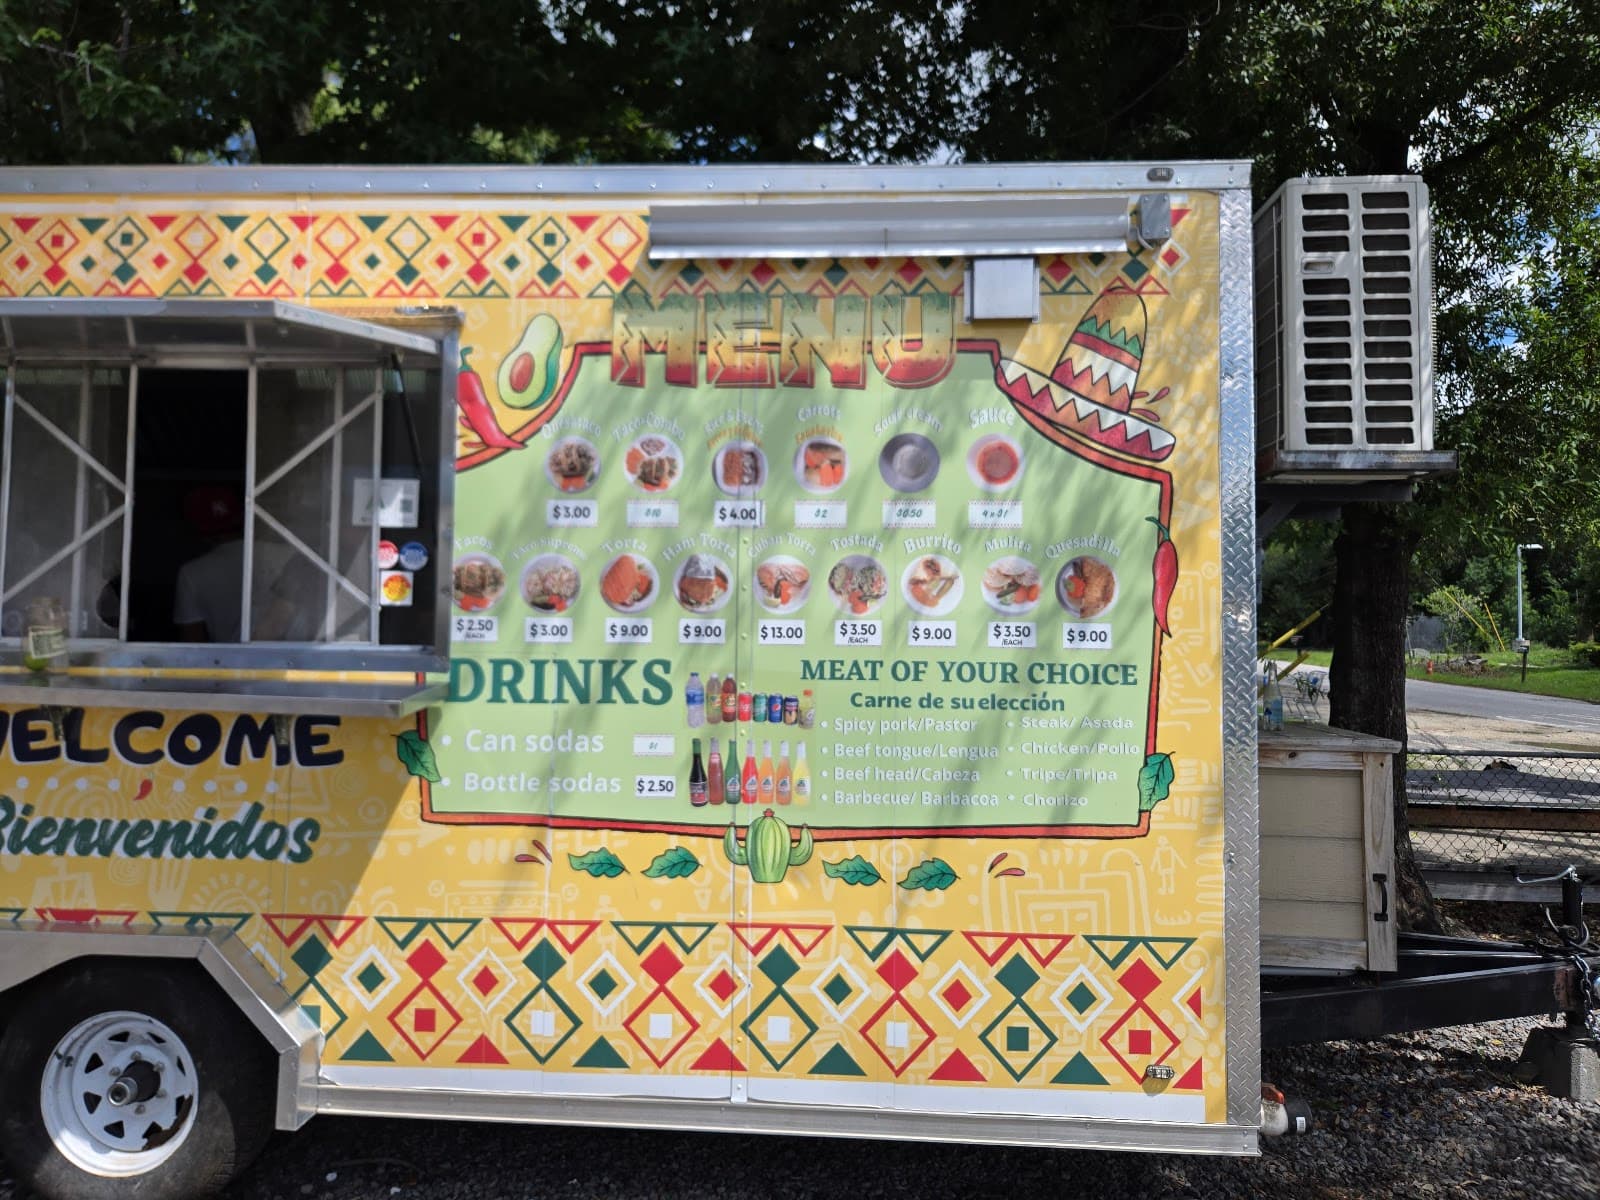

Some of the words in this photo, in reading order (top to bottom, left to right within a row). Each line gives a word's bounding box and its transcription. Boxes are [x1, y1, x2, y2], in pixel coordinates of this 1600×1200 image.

[610, 291, 957, 390] MENU
[797, 405, 841, 421] Carrots
[968, 407, 1015, 429] Sauce
[601, 538, 648, 553] Torta
[662, 536, 696, 561] Ham
[700, 532, 737, 559] Torta
[786, 532, 817, 557] Torta
[830, 533, 884, 553] Tostada
[903, 533, 962, 555] Burrito
[983, 534, 1032, 554] Mulita
[1044, 533, 1121, 560] Quesadilla
[444, 657, 674, 706] DRINKS
[800, 659, 884, 681] MEAT
[891, 660, 929, 682] OF
[937, 661, 1020, 683] YOUR
[1027, 662, 1138, 686] CHOICE
[850, 691, 912, 709] Carne
[918, 692, 944, 709] de
[950, 696, 975, 710] su
[978, 691, 1066, 711] elección
[834, 717, 876, 736] Spicy
[880, 717, 978, 736] pork/Pastor
[1080, 715, 1136, 730] Asada
[0, 706, 346, 767] ELCOME
[464, 728, 517, 753] Can
[525, 728, 605, 753] sodas
[833, 742, 871, 758] Beef
[875, 742, 999, 760] tongue/Lengua
[1020, 741, 1140, 755] Chicken/Pollo
[463, 772, 541, 793] Bottle
[548, 772, 622, 793] sodas
[833, 766, 870, 782] Beef
[874, 766, 981, 782] head/Cabeza
[920, 790, 999, 807] Barbacoa
[1022, 793, 1089, 807] Chorizo
